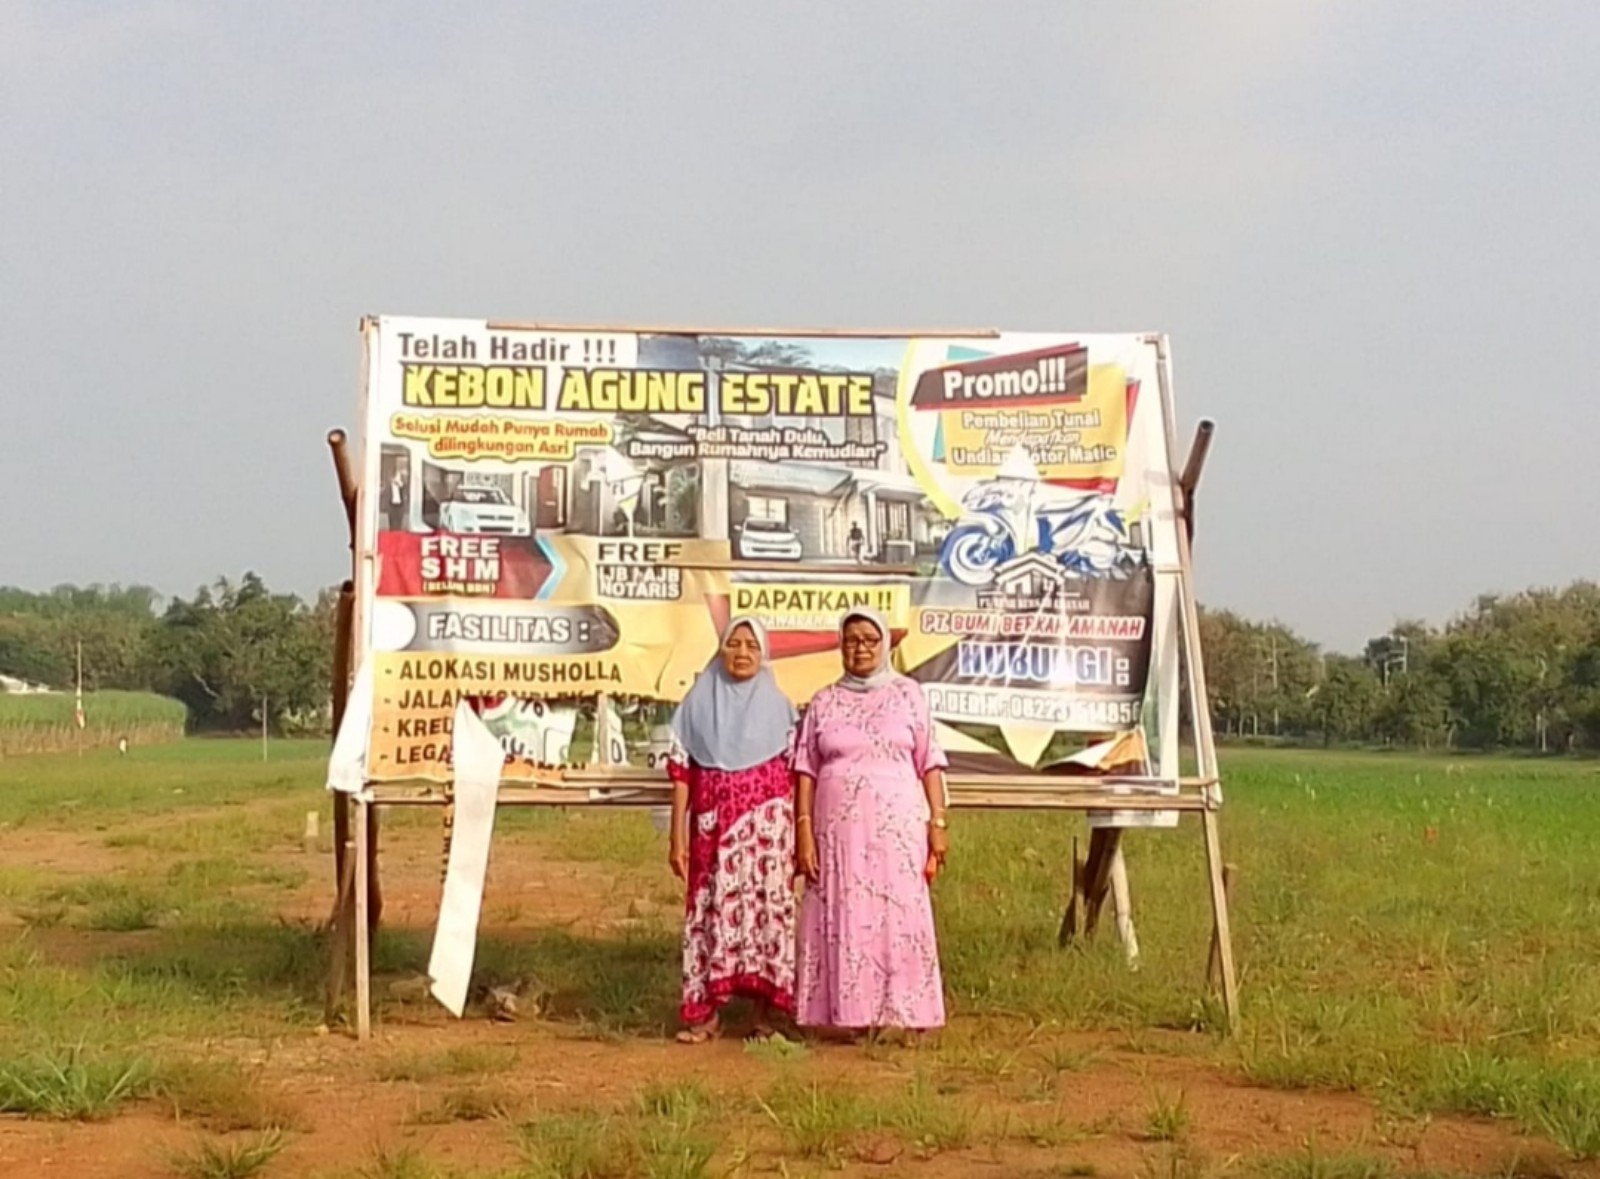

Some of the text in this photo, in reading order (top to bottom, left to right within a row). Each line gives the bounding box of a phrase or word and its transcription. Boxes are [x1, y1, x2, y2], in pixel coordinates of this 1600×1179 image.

[398, 332, 617, 364] Telah Hadir !!!
[404, 363, 875, 416] KEBON AGUNG ESTATE
[942, 358, 1067, 400] Promo!!!
[445, 419, 499, 435] Mudah
[503, 421, 550, 440] Punya
[554, 423, 608, 438] Rumah
[962, 409, 1101, 429] Pembelian Tunai
[434, 436, 570, 456] dilingkungan Asri
[729, 429, 781, 443] Tanah
[630, 441, 696, 459] Bangun
[699, 443, 789, 461] Rumahnya
[1069, 445, 1117, 464] Matic
[421, 536, 500, 558] FREE
[600, 580, 680, 598] NOTARIS
[737, 588, 892, 611] DAPATKAN !!
[428, 611, 571, 642] FASILITAS
[922, 612, 950, 632] PT.
[953, 613, 998, 633] BUMI
[1068, 616, 1143, 637] AMANAH
[399, 659, 622, 683] ALOKASI MUSHOLLA
